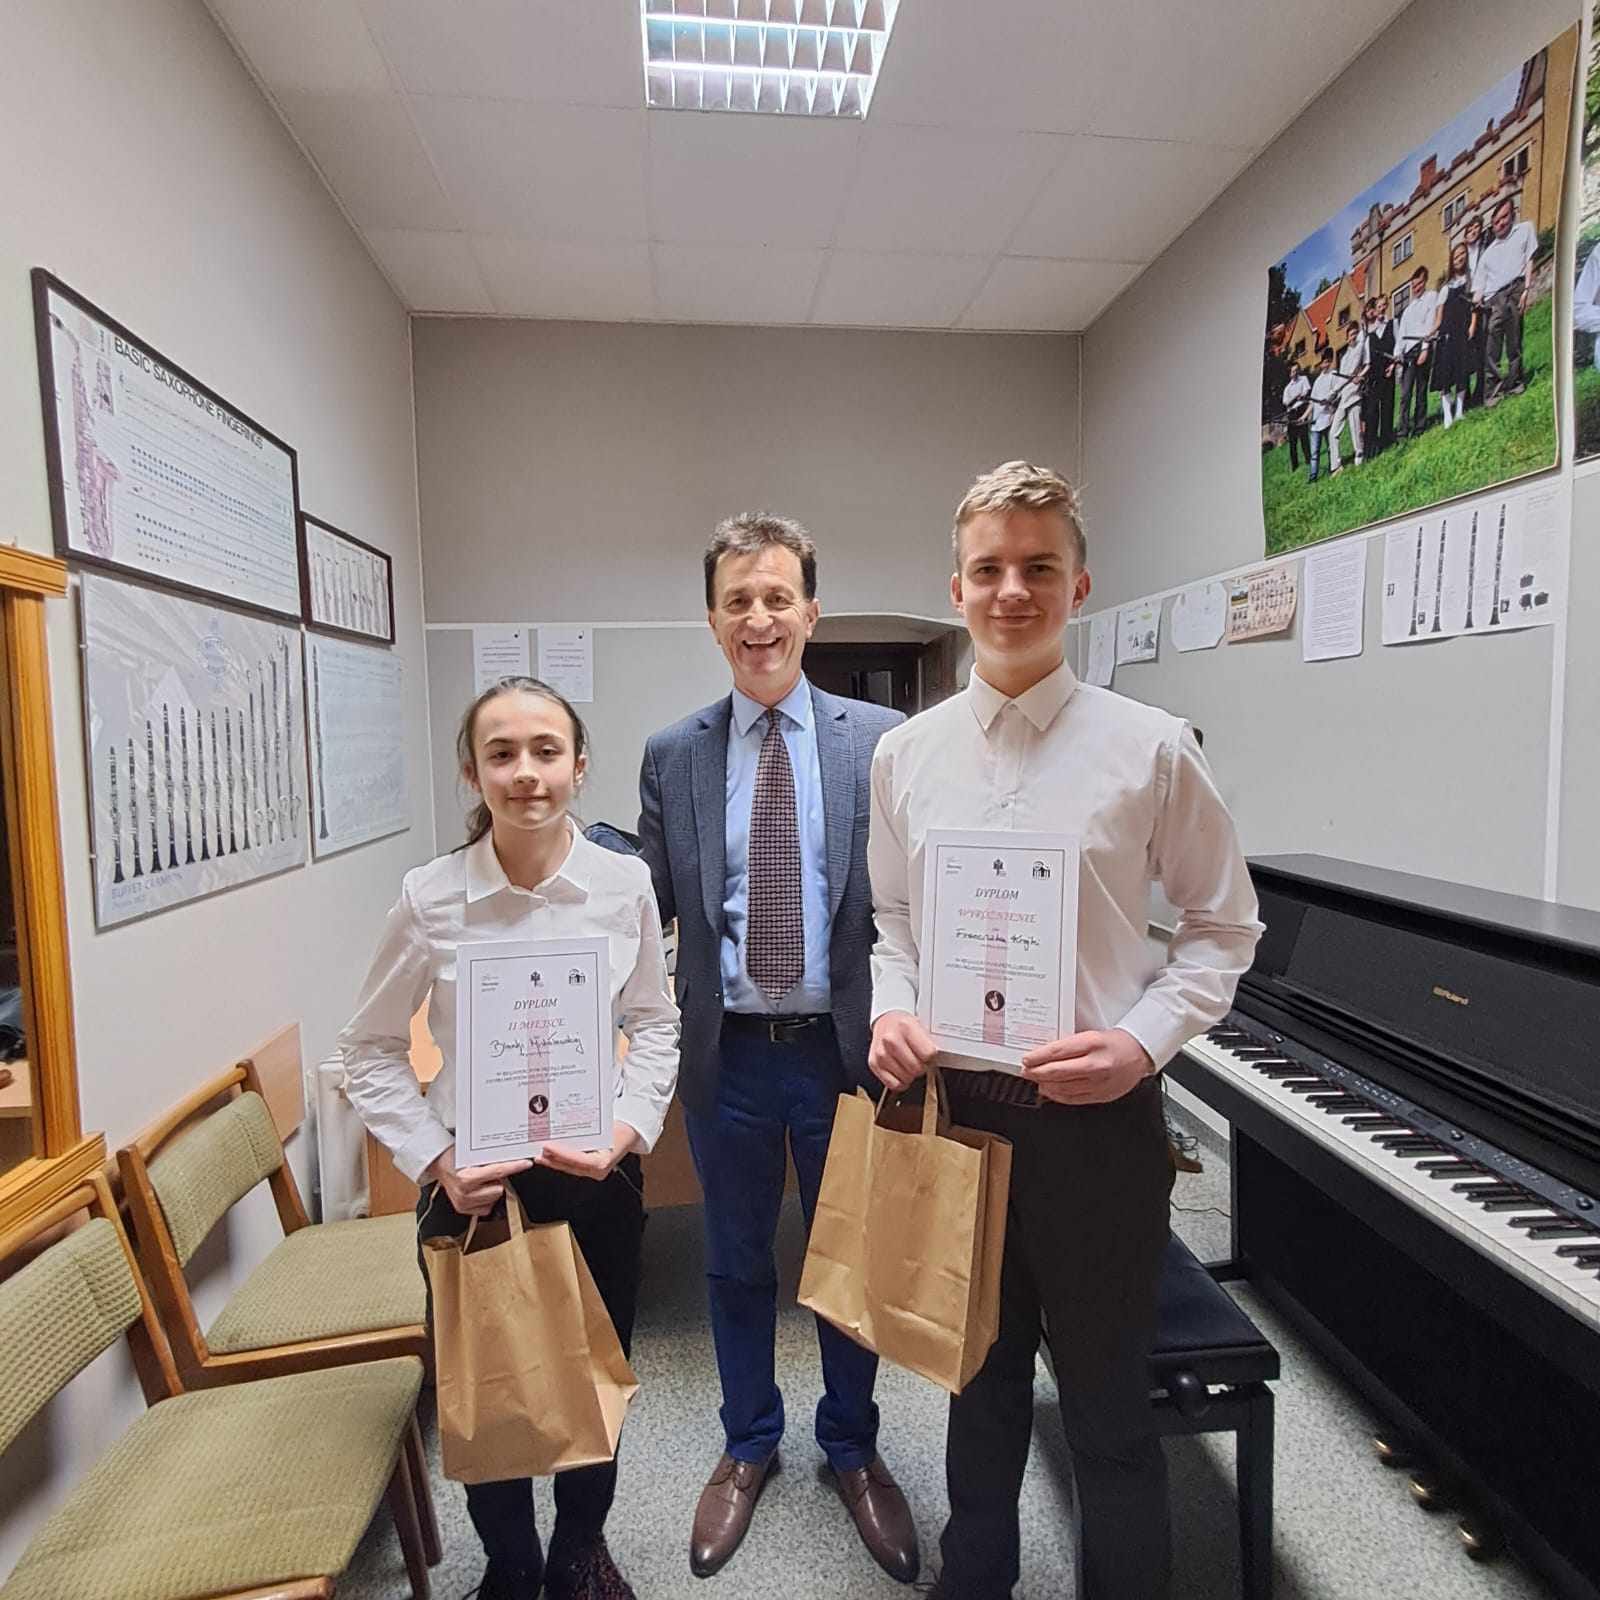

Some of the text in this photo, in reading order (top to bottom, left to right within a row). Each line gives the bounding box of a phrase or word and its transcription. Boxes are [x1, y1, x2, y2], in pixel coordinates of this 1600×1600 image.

[114, 337, 150, 373] BASIC
[153, 363, 215, 416] SAXOPHONE
[216, 409, 264, 450] FINGERINGS
[975, 887, 1020, 900] DYPLOM
[513, 998, 558, 1010] DYPLOM
